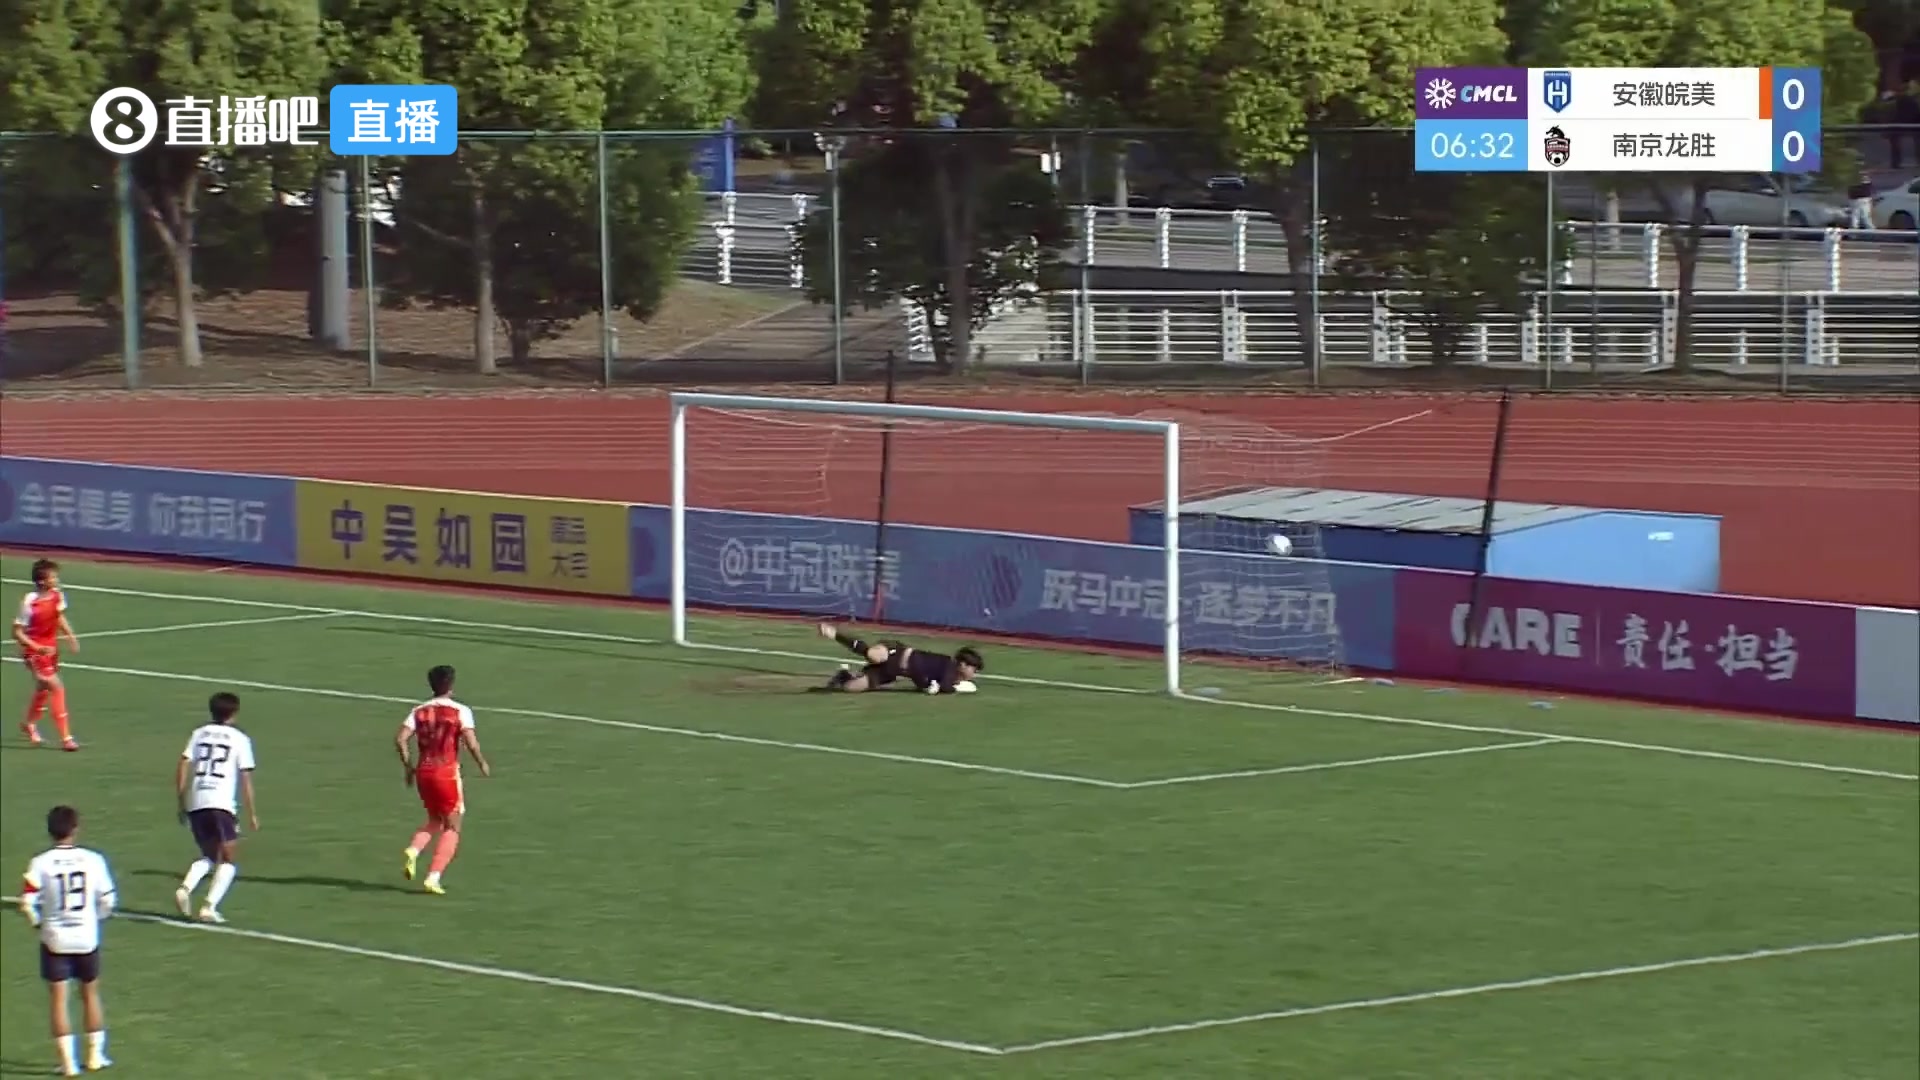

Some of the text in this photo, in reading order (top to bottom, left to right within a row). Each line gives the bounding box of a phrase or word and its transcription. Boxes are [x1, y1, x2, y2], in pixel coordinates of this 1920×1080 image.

[19, 482, 267, 543] 全民健身 你我同行
[330, 499, 527, 573] 中吴如园
[53, 871, 87, 912] 19
